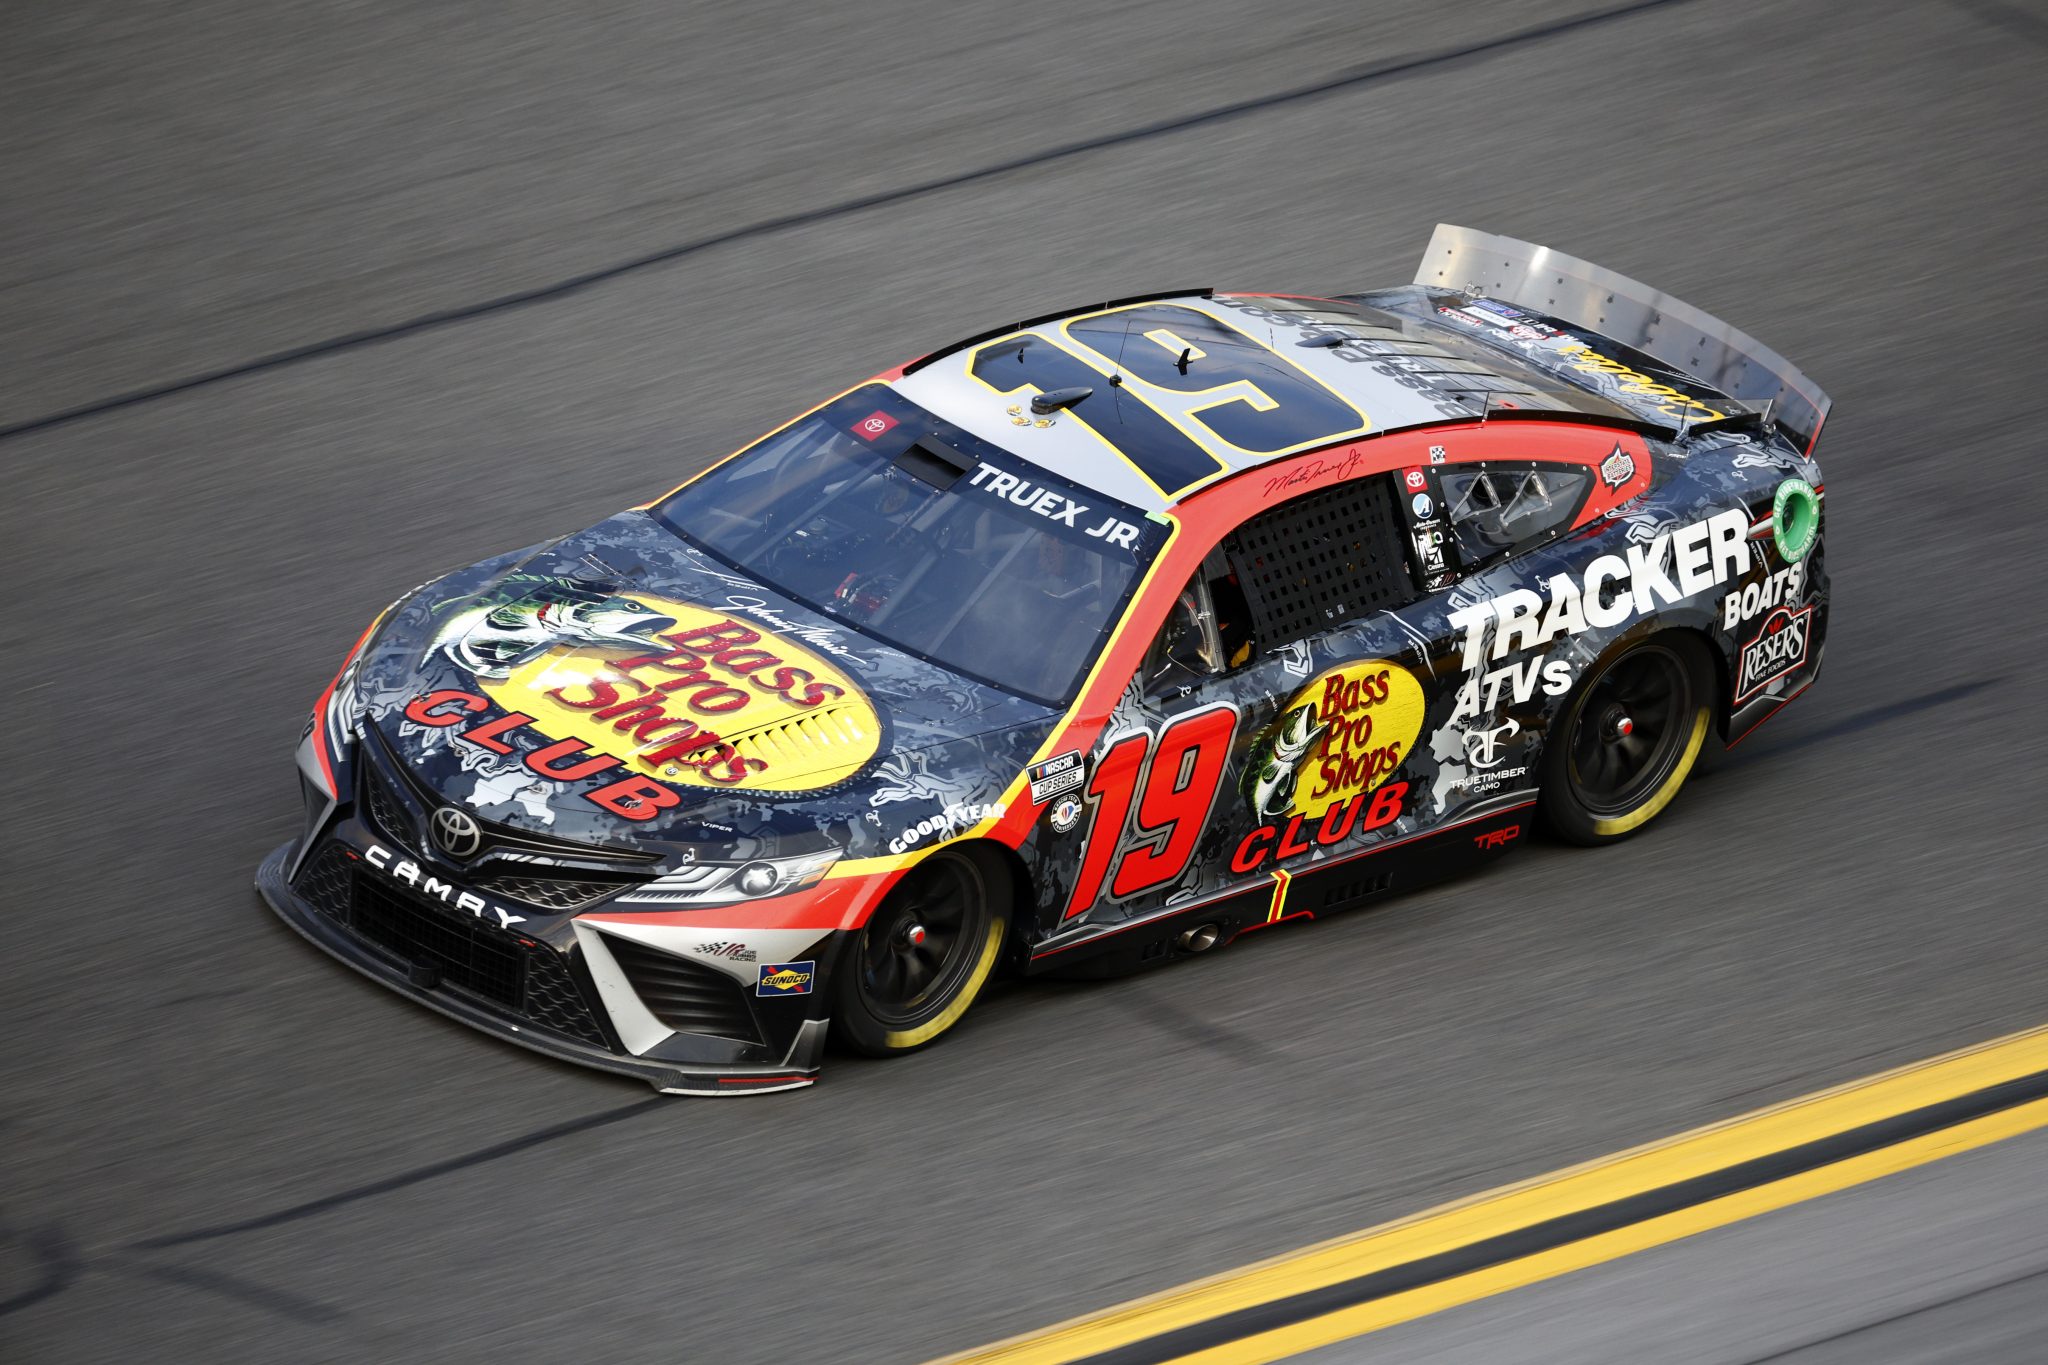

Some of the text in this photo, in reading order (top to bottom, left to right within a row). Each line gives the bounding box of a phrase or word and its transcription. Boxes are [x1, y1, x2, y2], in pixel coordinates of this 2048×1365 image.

[965, 303, 1371, 503] 19
[968, 461, 1091, 528] TRUEX
[1446, 508, 1751, 673] TRACKER
[1722, 561, 1802, 632] BOATS
[604, 647, 751, 717] Pro
[659, 618, 845, 709] Bass
[1742, 617, 1805, 693] RESER'S
[1754, 658, 1787, 683] FINE FOODS
[1318, 669, 1391, 721] Bass
[404, 688, 683, 823] CLUB
[544, 676, 768, 786] Shops
[1317, 714, 1373, 759] Pro
[1038, 771, 1077, 796] CUP SERIES
[1044, 755, 1075, 776] NASCAR
[1311, 741, 1401, 800] Shops
[1449, 766, 1526, 789] TRUETIMBER
[1473, 781, 1501, 794] CAMO
[701, 820, 734, 833] VIPER
[888, 802, 1006, 855] GOODYEAR
[1062, 704, 1238, 928] 19
[1231, 781, 1409, 874] CLUB
[1474, 824, 1520, 849] TRD
[364, 844, 528, 930] CAMRY
[763, 974, 808, 986] SUNOCO
